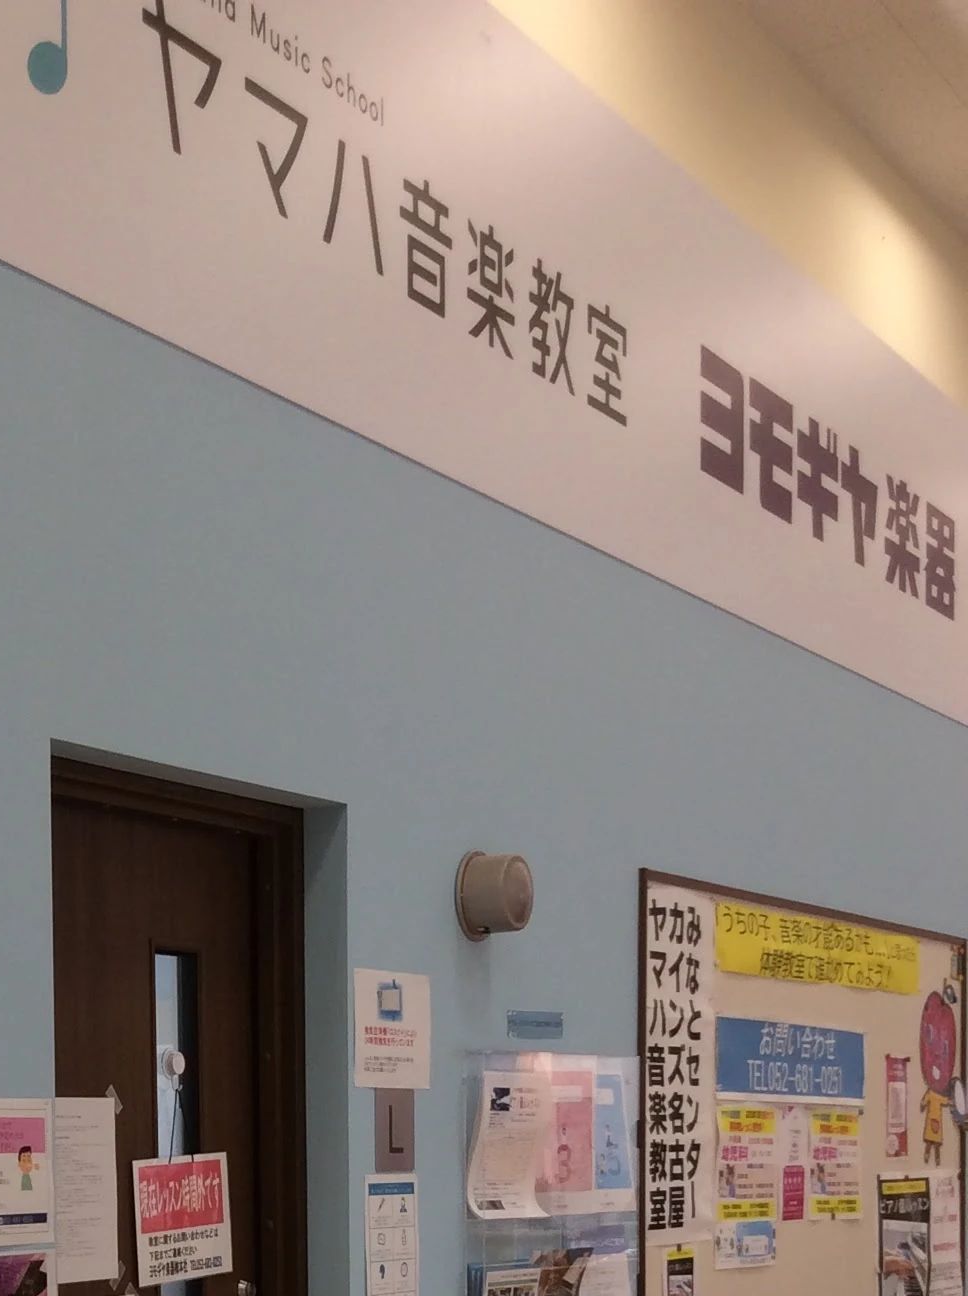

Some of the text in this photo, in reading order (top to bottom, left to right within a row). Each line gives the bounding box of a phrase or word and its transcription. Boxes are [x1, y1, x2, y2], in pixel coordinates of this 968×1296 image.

[141, 0, 628, 427] ヤマハ音楽教室
[250, 4, 385, 127] Music School
[699, 344, 957, 622] ヨモギヤ楽器
[647, 898, 668, 1231] ヤマハ音楽教室
[668, 902, 685, 1229] カインズ名古屋
[686, 906, 702, 1219] みなとセンター
[758, 1022, 838, 1061] お問い合わせ
